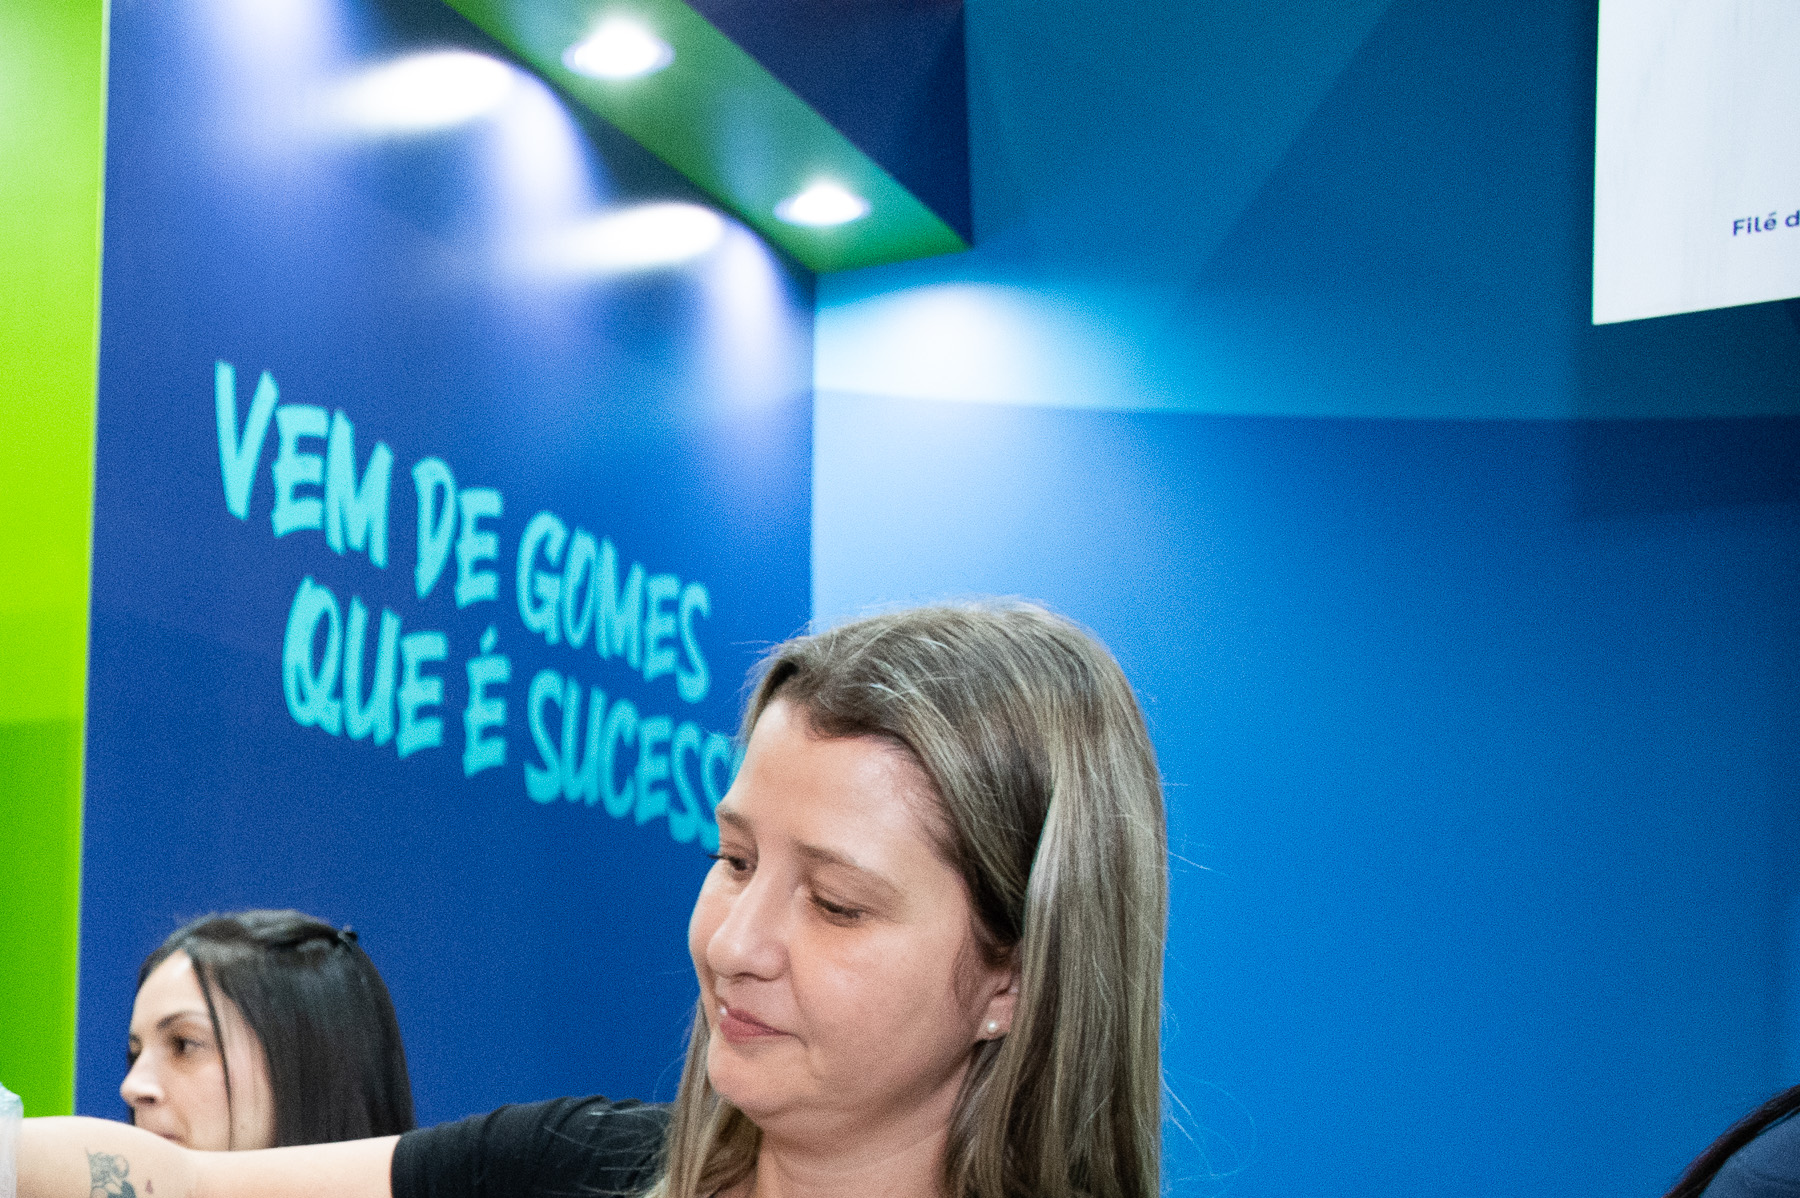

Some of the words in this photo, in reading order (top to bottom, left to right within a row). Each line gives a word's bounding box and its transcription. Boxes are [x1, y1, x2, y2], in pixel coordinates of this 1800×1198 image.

[1732, 211, 1777, 237] Filé
[215, 359, 394, 569] VEM
[411, 456, 504, 609] DE
[516, 510, 711, 703] GOMES
[282, 575, 449, 759] QUE
[464, 624, 512, 778] É
[524, 668, 742, 852] SUCESS
